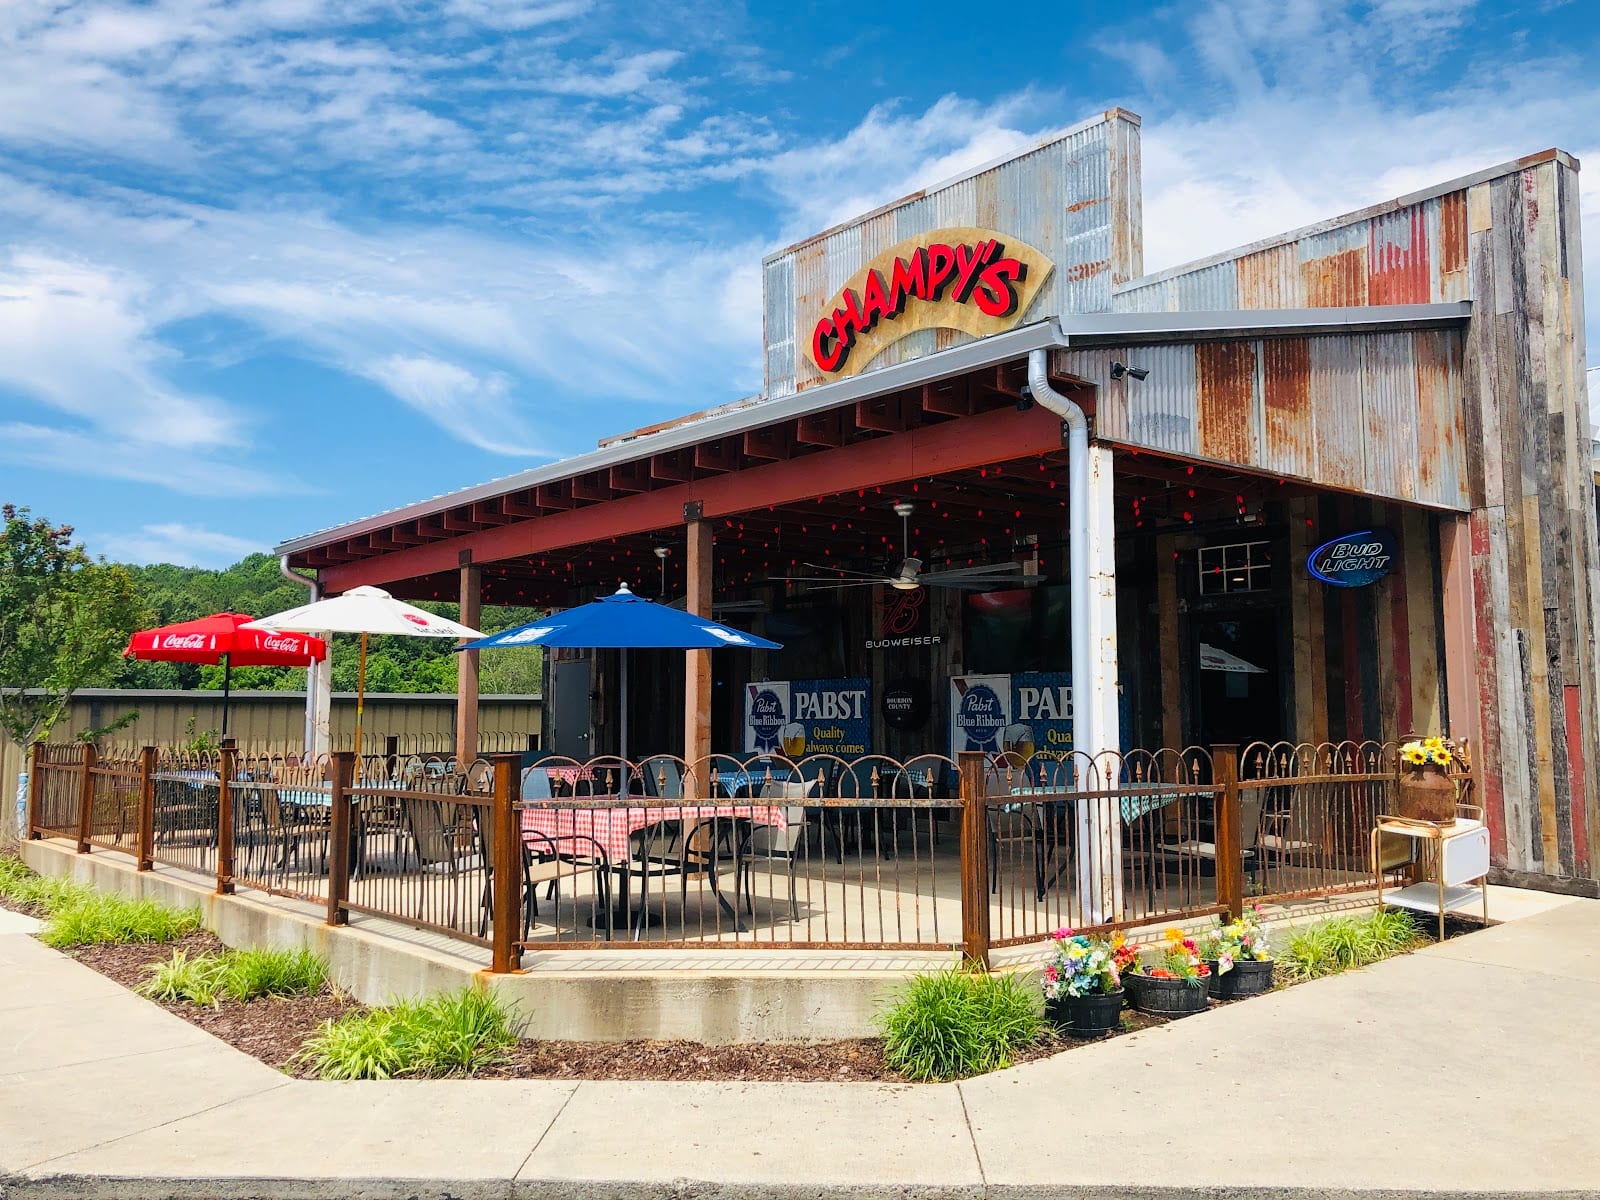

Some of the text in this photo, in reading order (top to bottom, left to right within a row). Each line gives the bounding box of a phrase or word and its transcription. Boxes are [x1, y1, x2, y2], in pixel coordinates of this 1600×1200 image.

[812, 238, 1029, 373] CHAMPY'S
[1331, 542, 1383, 559] BUD
[1320, 556, 1391, 573] LIGHT
[163, 633, 207, 650] Coca-Cola
[263, 635, 301, 653] Coca-Cola
[865, 635, 942, 649] BUDWEISER
[756, 697, 778, 713] Pabst
[794, 690, 866, 719] PABST
[966, 693, 994, 712] Pabst
[749, 715, 786, 726] Blue Ribbon
[957, 714, 1007, 727] Blue Ribbon
[813, 725, 846, 742] Quality
[805, 740, 865, 754] always comes
